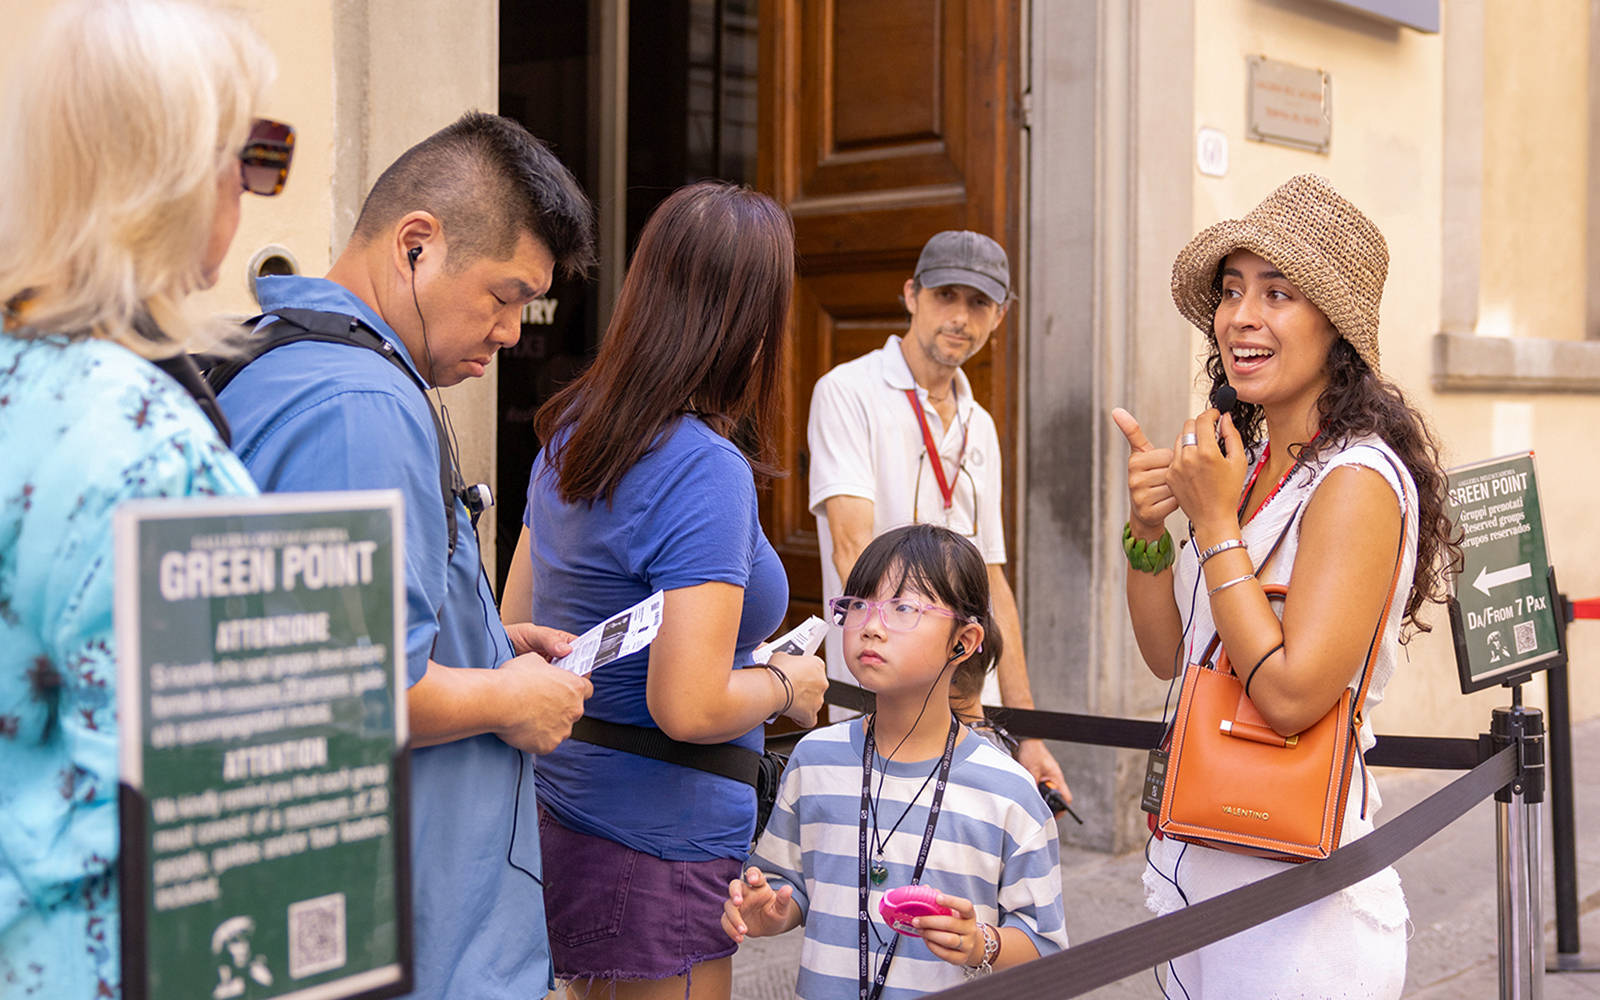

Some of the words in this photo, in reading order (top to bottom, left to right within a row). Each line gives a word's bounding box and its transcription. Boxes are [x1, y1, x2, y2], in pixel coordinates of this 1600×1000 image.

[522, 298, 558, 324] TRY
[1448, 482, 1490, 507] GREEN
[1492, 472, 1527, 497] POINT
[1460, 505, 1487, 522] Gruppi
[1488, 496, 1524, 516] prenotati
[1461, 533, 1489, 548] Grupos
[1490, 523, 1531, 541] reservados
[1462, 516, 1498, 535] Reserved
[1499, 511, 1525, 528] groups
[160, 547, 276, 601] GREEN
[282, 540, 378, 592] POINT
[1516, 599, 1523, 617] 7
[216, 612, 331, 652] ATTENZIONE
[223, 737, 328, 782] ATTENTION
[1222, 805, 1270, 821] VALENTINO
